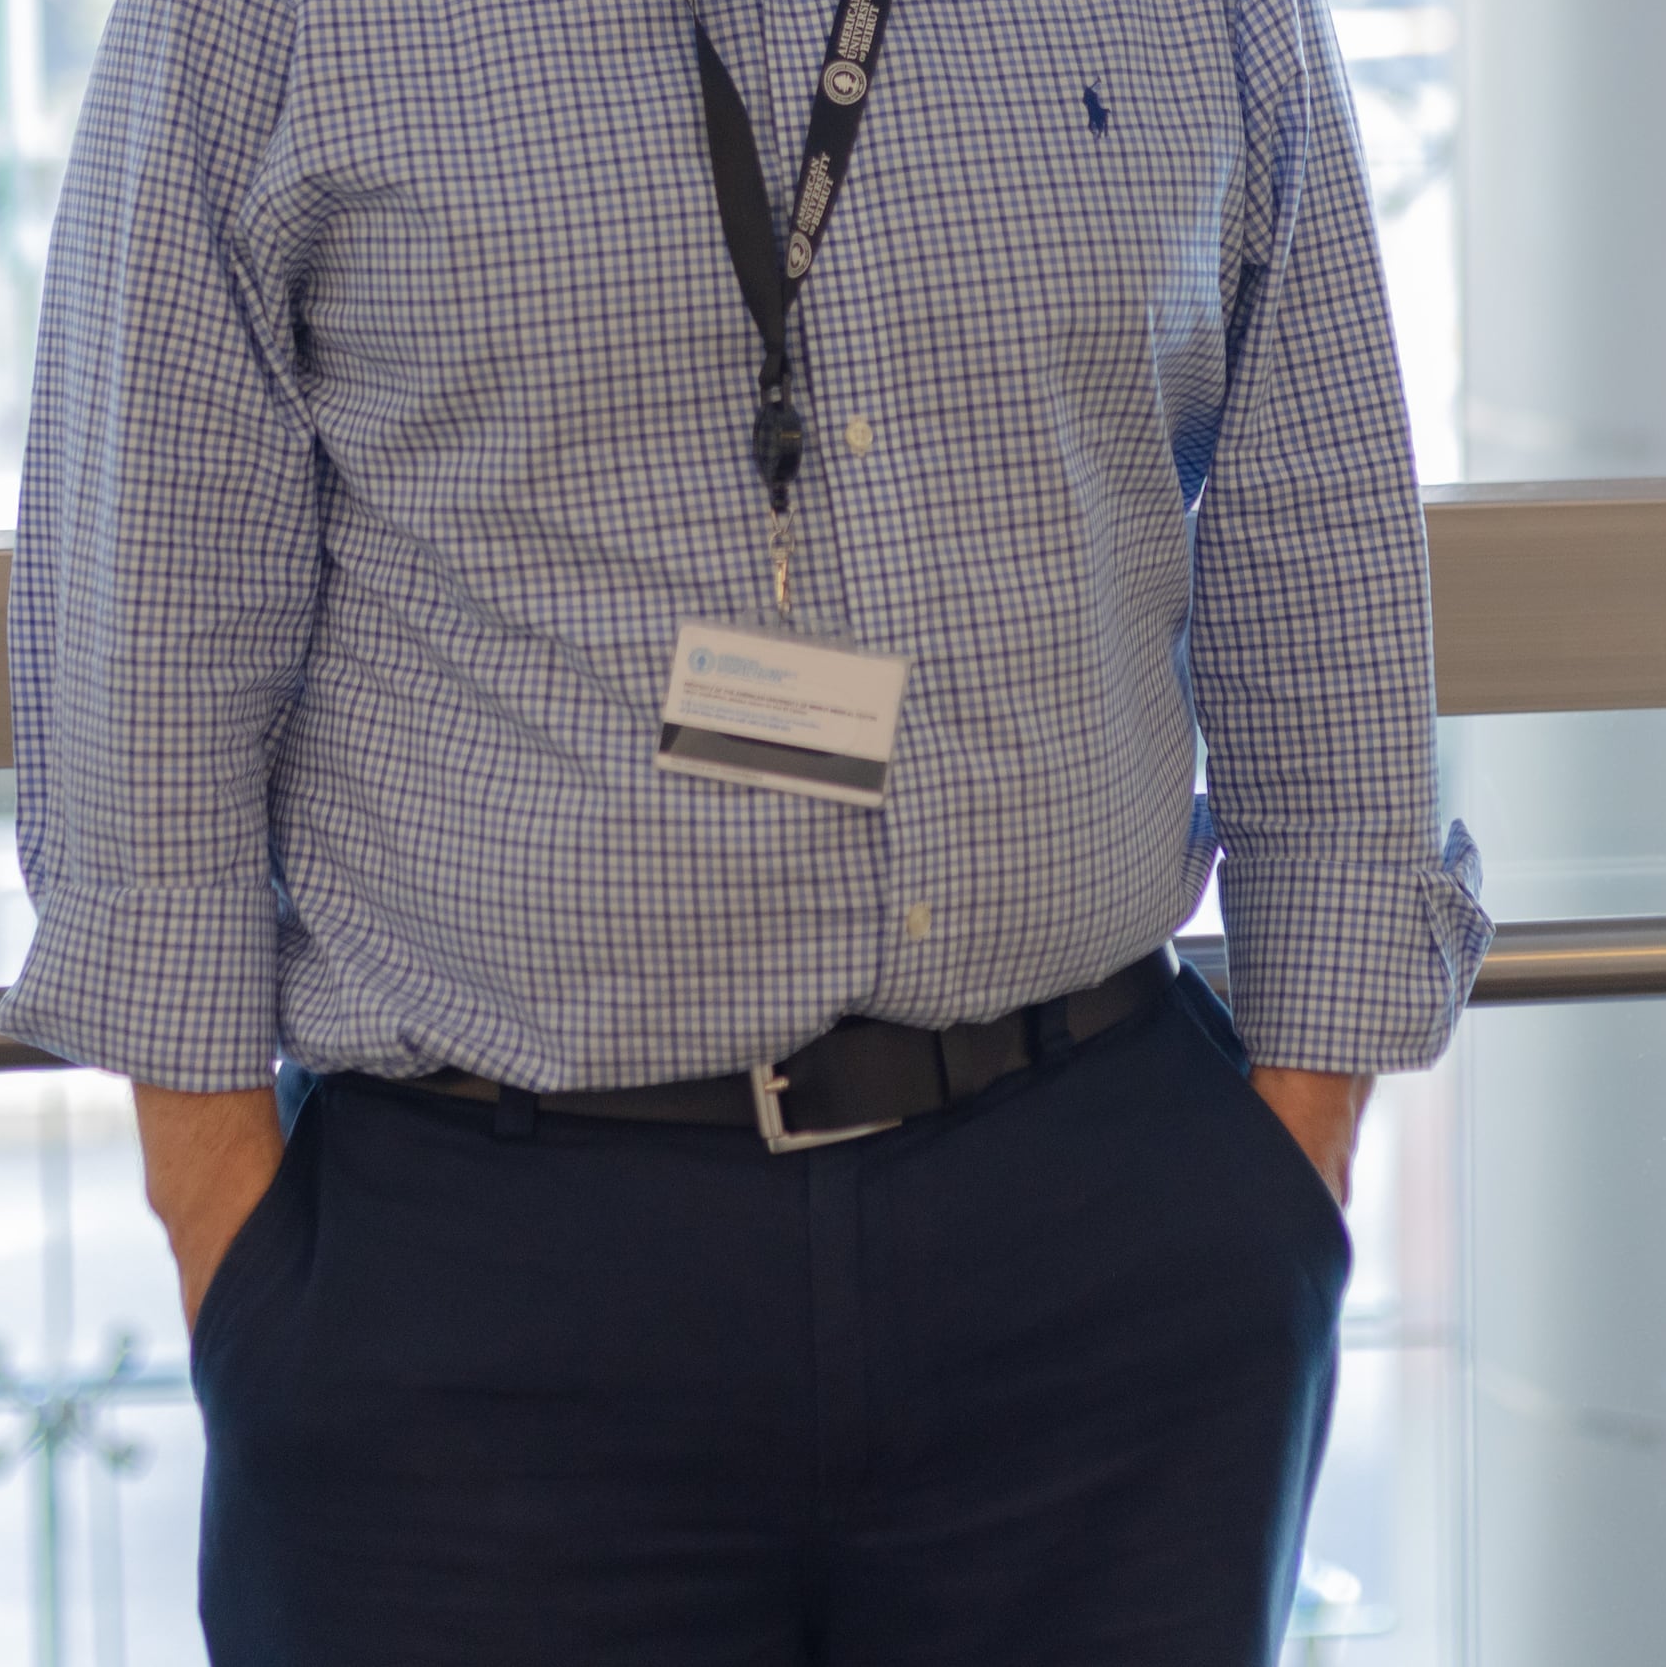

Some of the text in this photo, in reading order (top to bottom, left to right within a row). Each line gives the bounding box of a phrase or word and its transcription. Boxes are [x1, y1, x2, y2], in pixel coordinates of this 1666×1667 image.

[859, 5, 880, 52] BEIRUT
[800, 151, 831, 232] UNIVERSITY
[811, 175, 834, 227] BEIRUT
